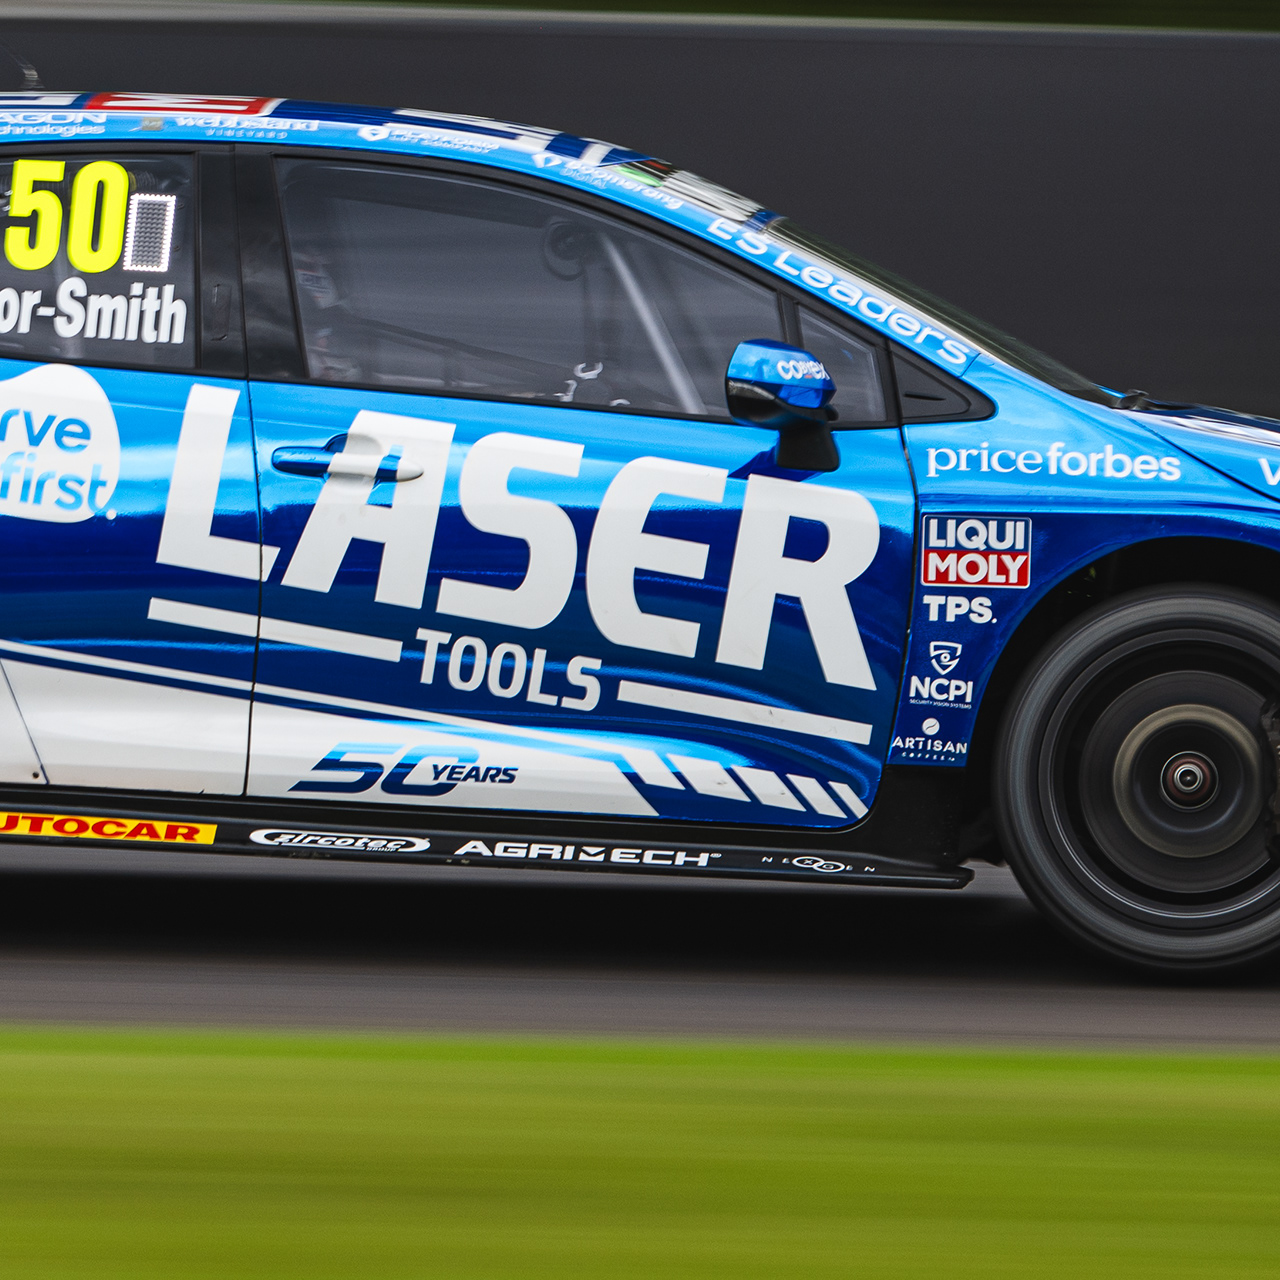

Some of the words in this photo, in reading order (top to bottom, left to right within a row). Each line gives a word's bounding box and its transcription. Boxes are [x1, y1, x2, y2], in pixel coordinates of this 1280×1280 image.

[560, 168, 608, 190] DIGITAL
[4, 159, 130, 273] 50
[706, 218, 772, 255] ES
[773, 250, 971, 365] Leaders
[156, 383, 881, 691] LASER
[927, 518, 1026, 552] LIQUI
[926, 552, 1028, 584] MOLY
[416, 628, 603, 711] TOOLS
[909, 675, 973, 703] NCPI
[891, 736, 968, 754] ARTISAN
[431, 763, 518, 784] YEARS
